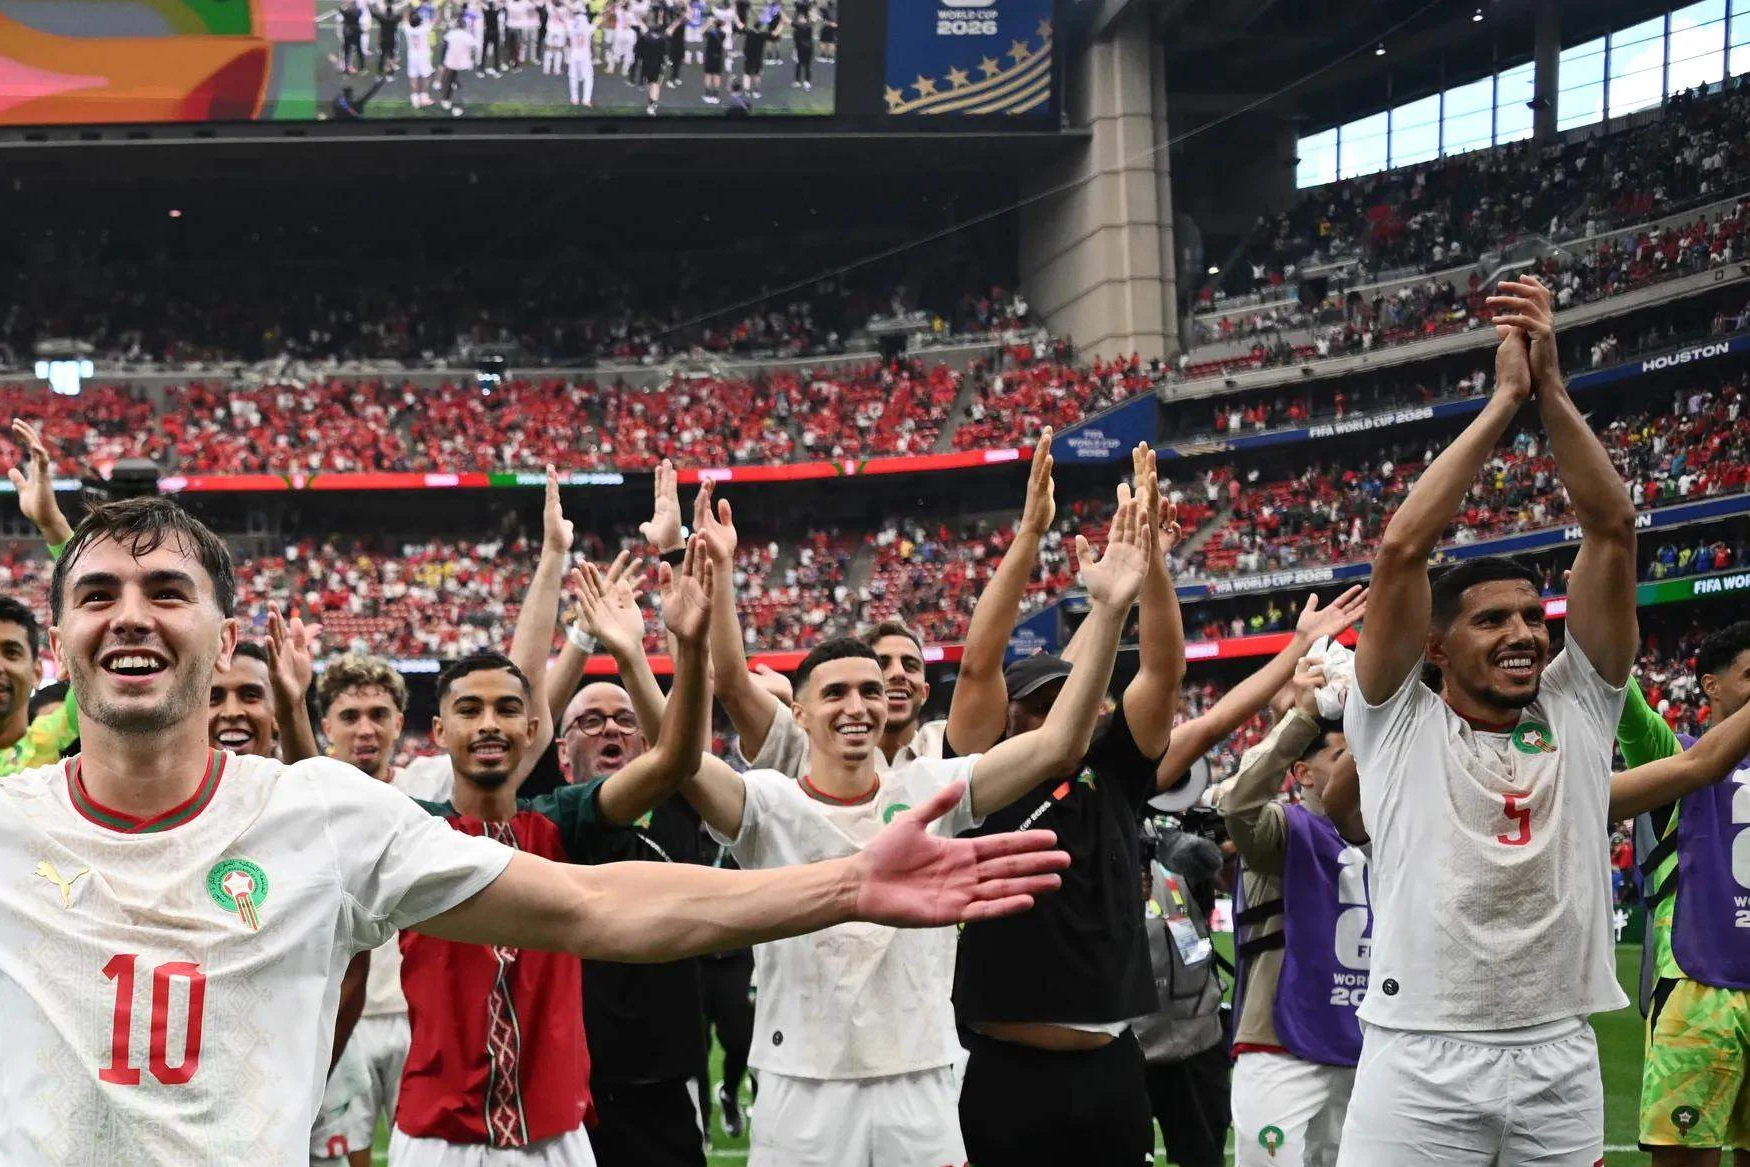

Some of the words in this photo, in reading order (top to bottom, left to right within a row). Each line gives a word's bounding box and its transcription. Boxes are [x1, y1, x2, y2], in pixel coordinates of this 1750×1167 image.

[937, 20, 998, 35] 2026
[1642, 341, 1729, 372] HOUSTON
[1309, 424, 1334, 438] FIFA
[1335, 418, 1372, 434] WORLD
[1373, 413, 1395, 428] CUP
[1234, 575, 1272, 591] WORLD
[1272, 572, 1294, 587] CUP
[1694, 578, 1722, 594] FIFA
[1498, 792, 1531, 846] 5
[1333, 972, 1370, 986] WOR
[98, 953, 207, 1085] 10
